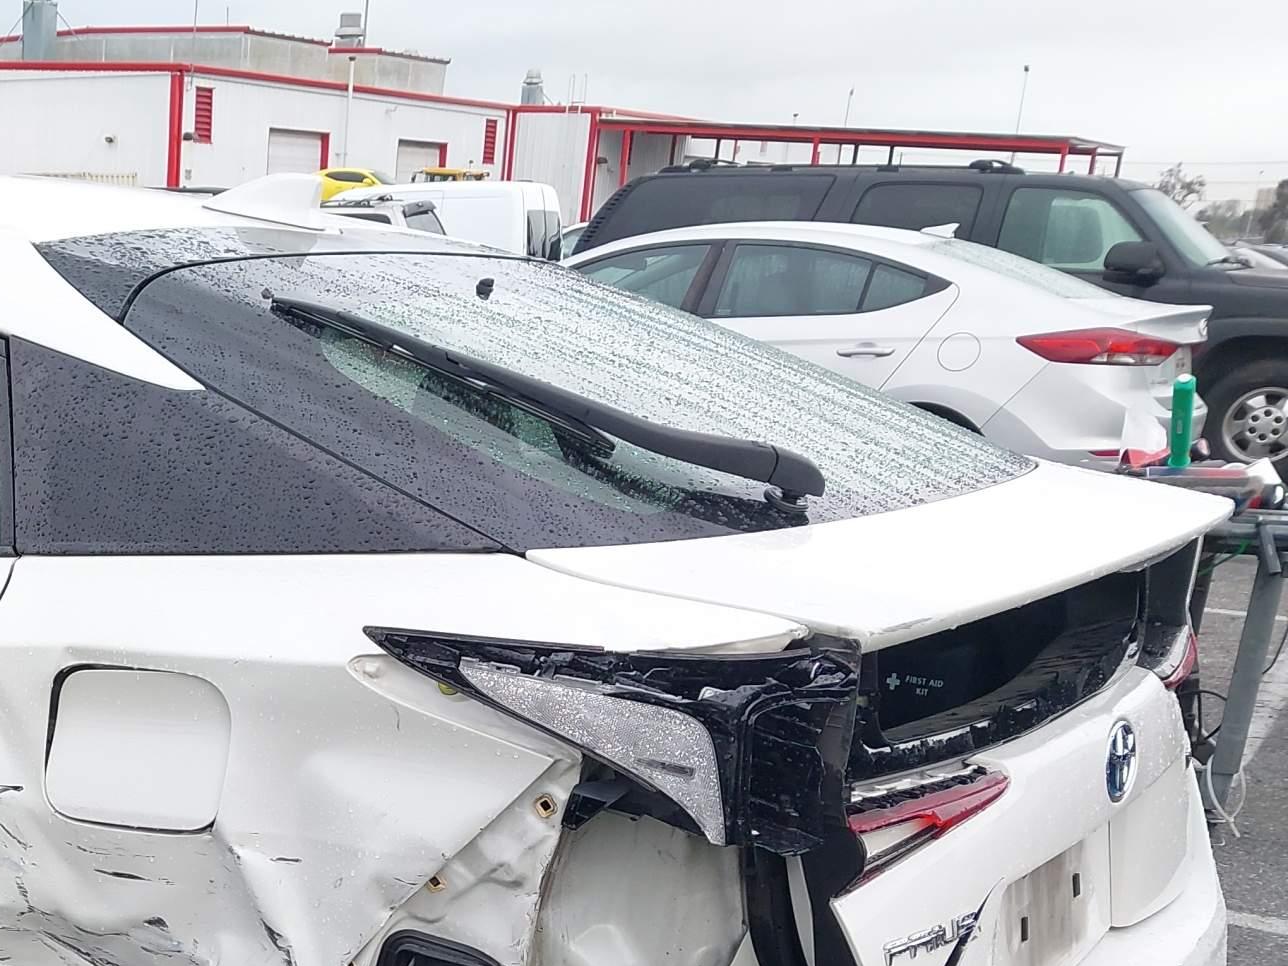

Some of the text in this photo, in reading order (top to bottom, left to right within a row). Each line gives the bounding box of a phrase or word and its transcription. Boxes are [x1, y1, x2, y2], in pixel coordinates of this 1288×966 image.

[905, 674, 944, 688] FIRST AID
[915, 687, 929, 697] KIT
